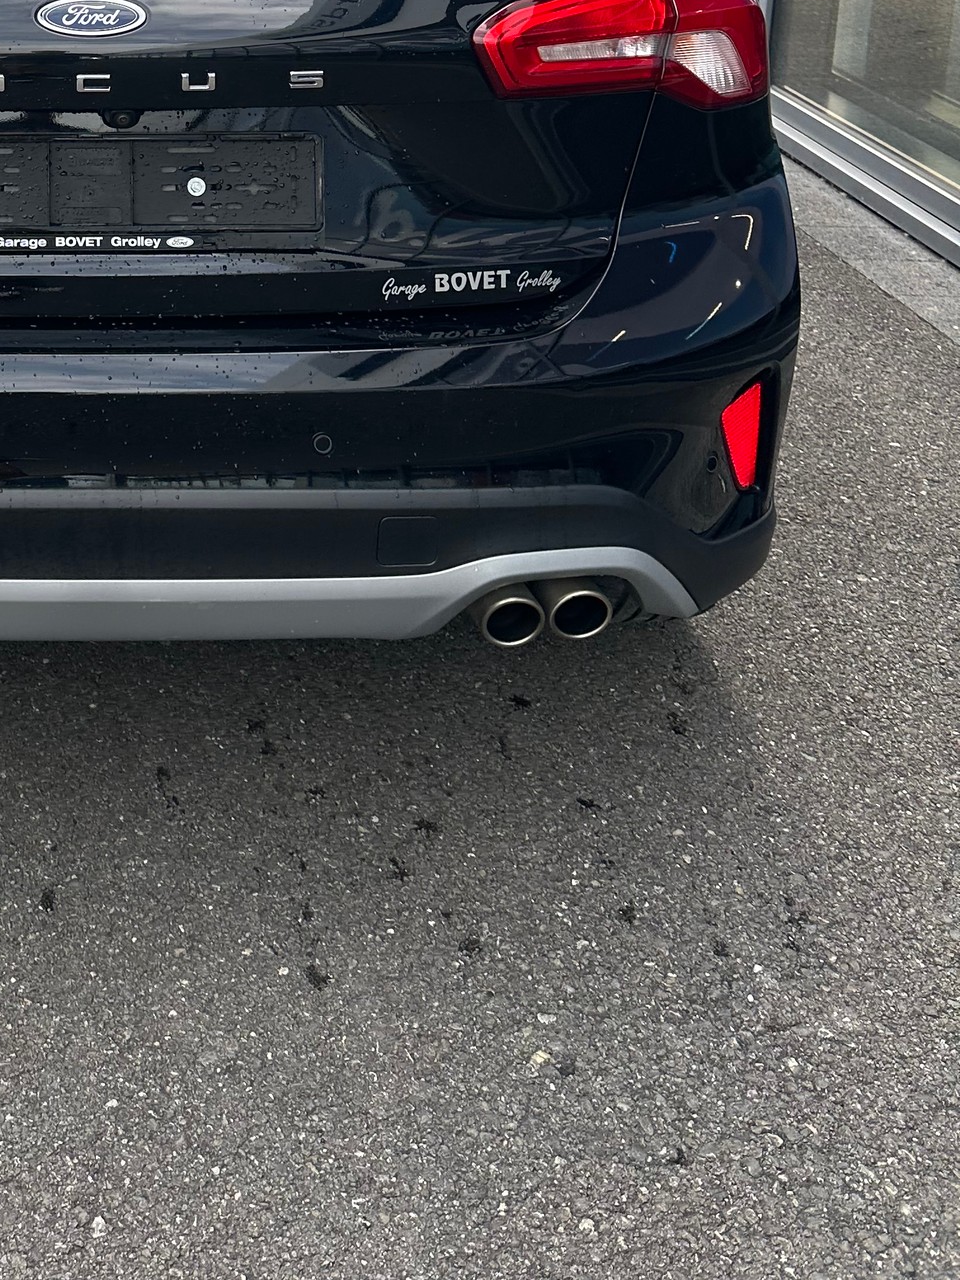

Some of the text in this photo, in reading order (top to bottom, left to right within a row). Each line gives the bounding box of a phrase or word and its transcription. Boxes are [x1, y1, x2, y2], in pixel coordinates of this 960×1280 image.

[62, 4, 120, 26] Ford
[55, 236, 103, 247] BOVET
[110, 236, 161, 249] Grolley
[382, 269, 561, 301] Garage BOVET Grolley
